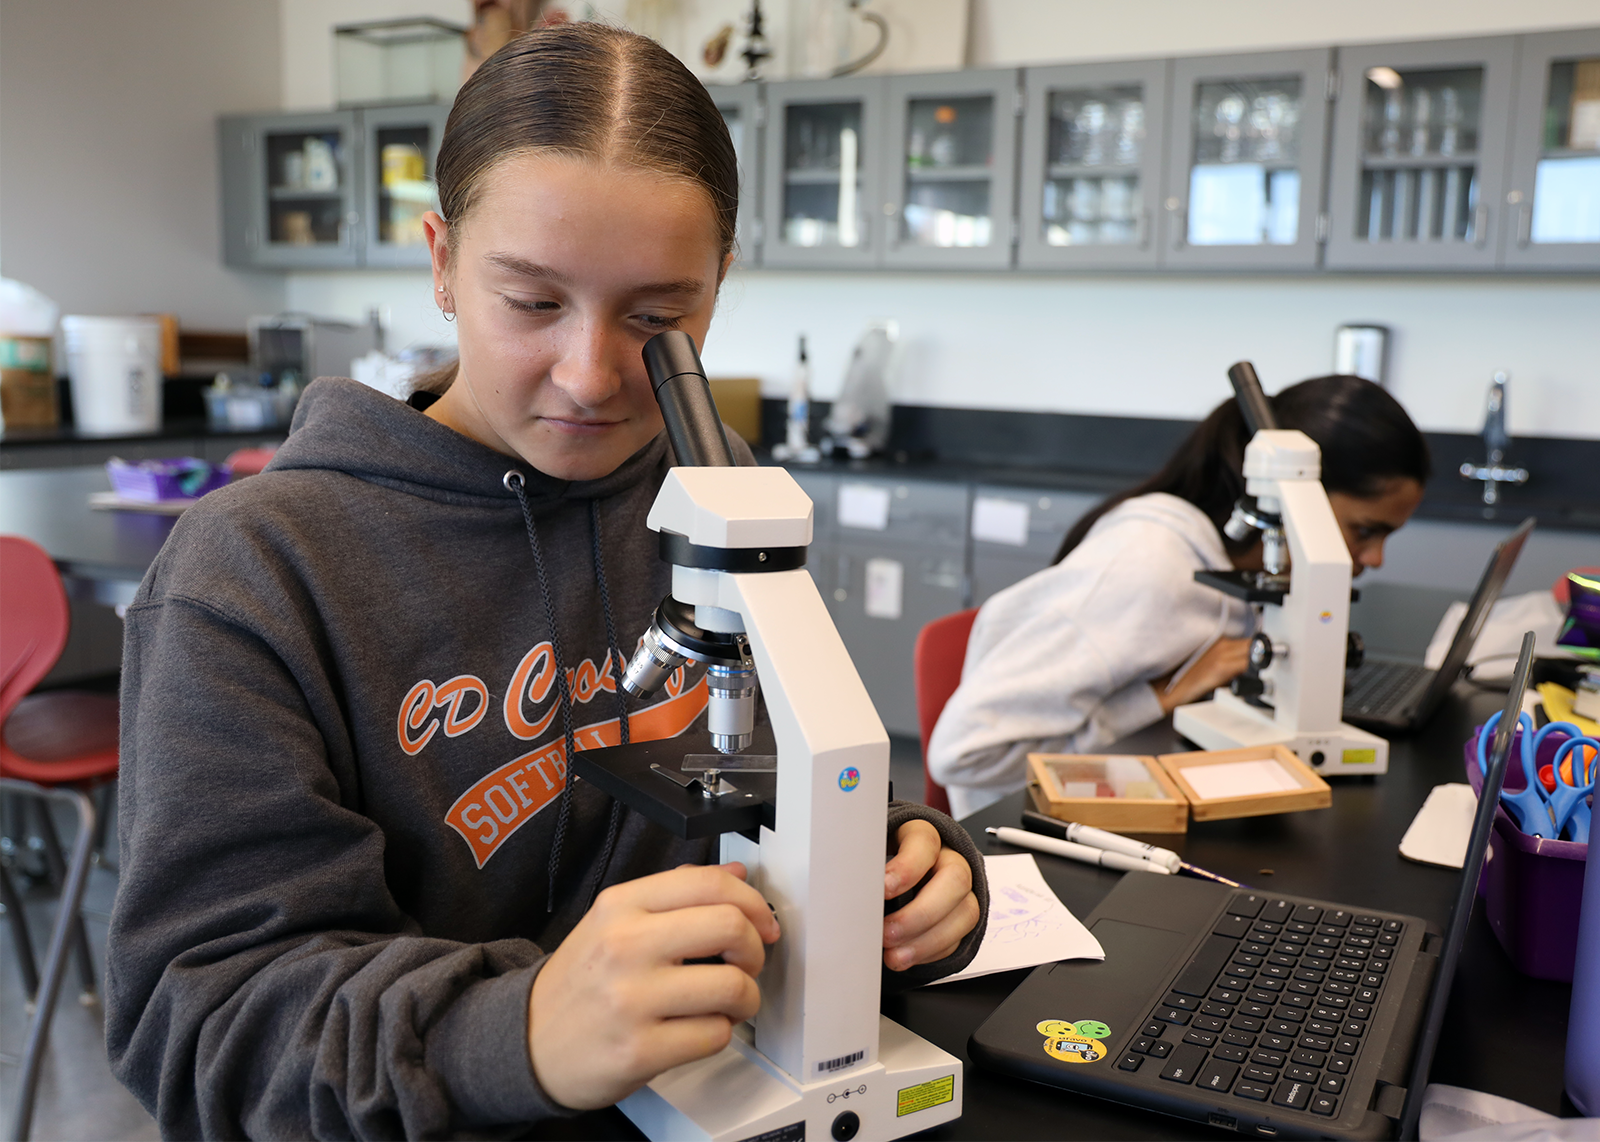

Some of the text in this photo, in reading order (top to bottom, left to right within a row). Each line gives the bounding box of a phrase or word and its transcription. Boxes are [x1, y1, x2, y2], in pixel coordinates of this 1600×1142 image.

[398, 674, 489, 756] CD
[1173, 1068, 1183, 1078] shift
[1210, 1075, 1220, 1087] enter
[1286, 1082, 1302, 1104] backspace
